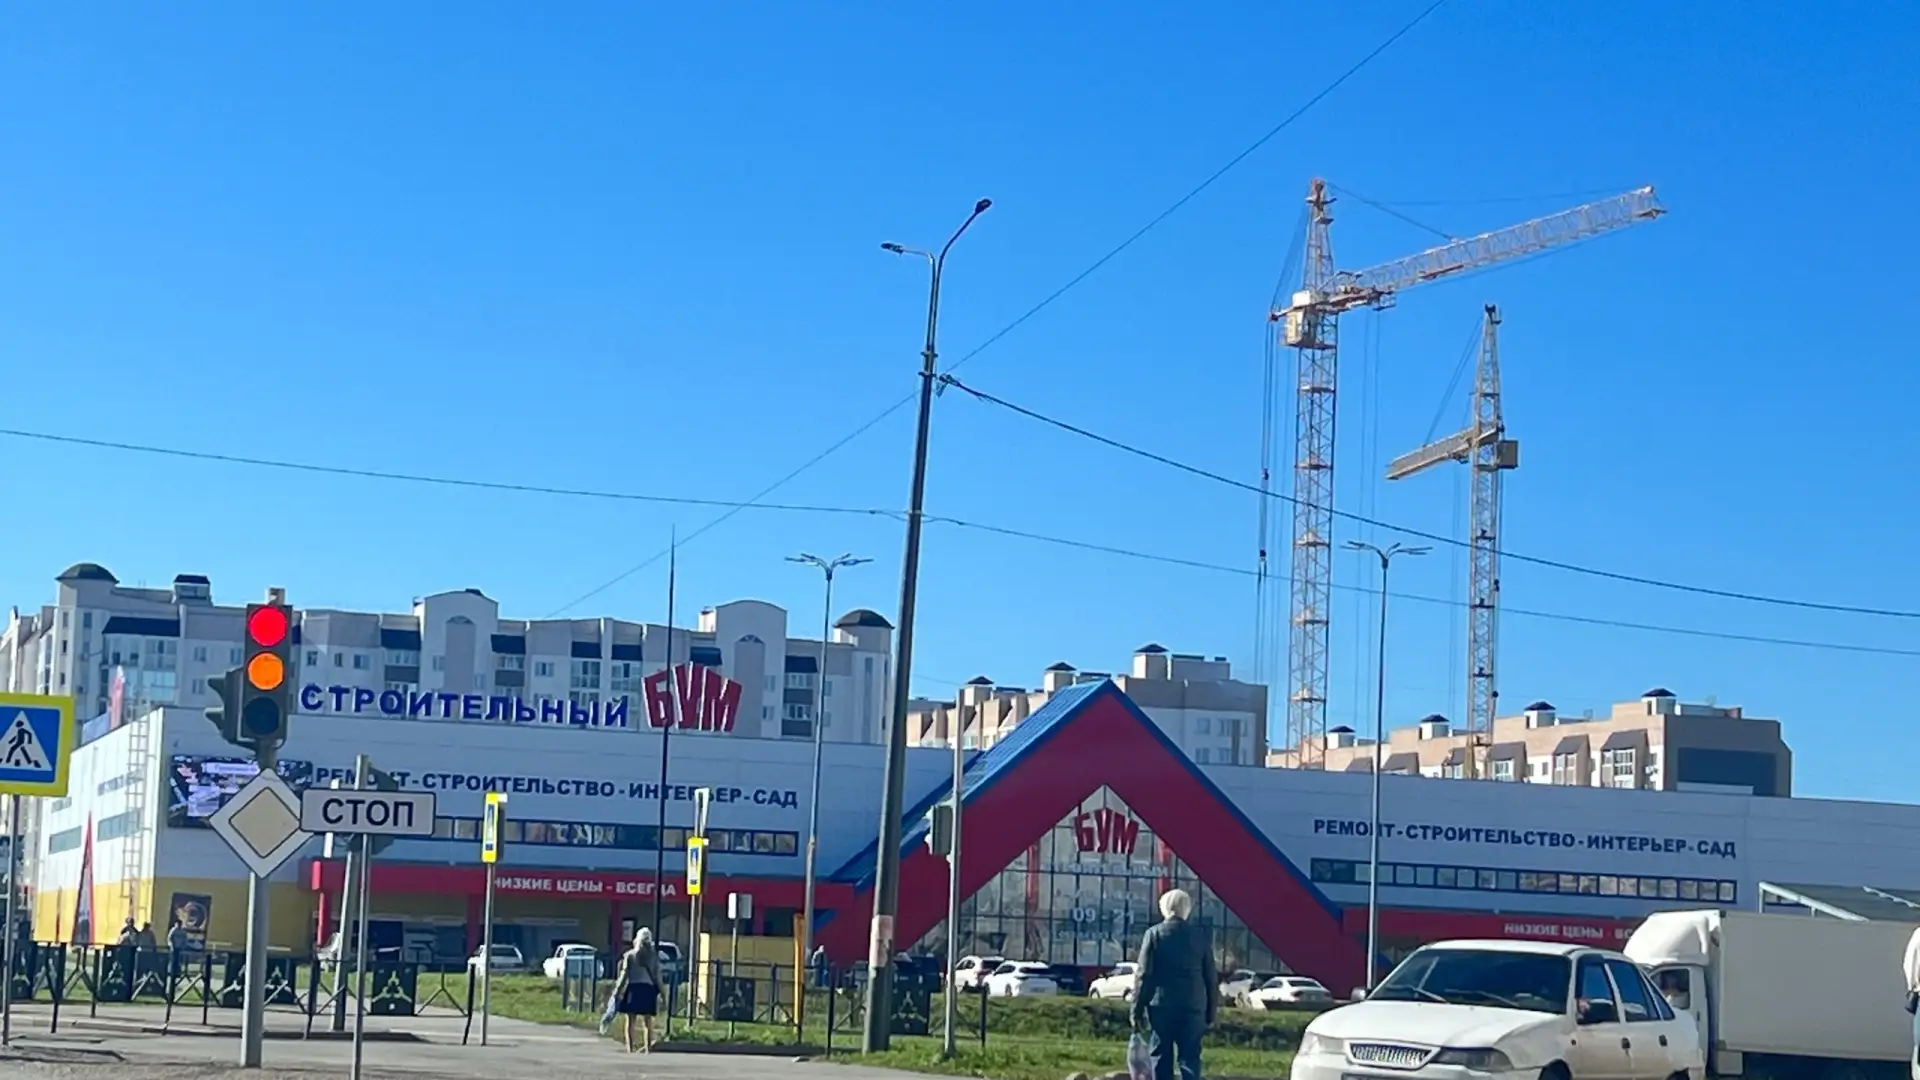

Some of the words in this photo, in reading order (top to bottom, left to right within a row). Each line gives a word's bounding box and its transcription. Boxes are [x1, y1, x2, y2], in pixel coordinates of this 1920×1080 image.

[300, 683, 628, 728] СТРОИТЕЛЬНЫЙ
[641, 661, 743, 732] БУМ
[322, 798, 414, 828] СТОП
[1073, 807, 1140, 855] БУМ
[556, 879, 603, 894] ЦЕНЫ
